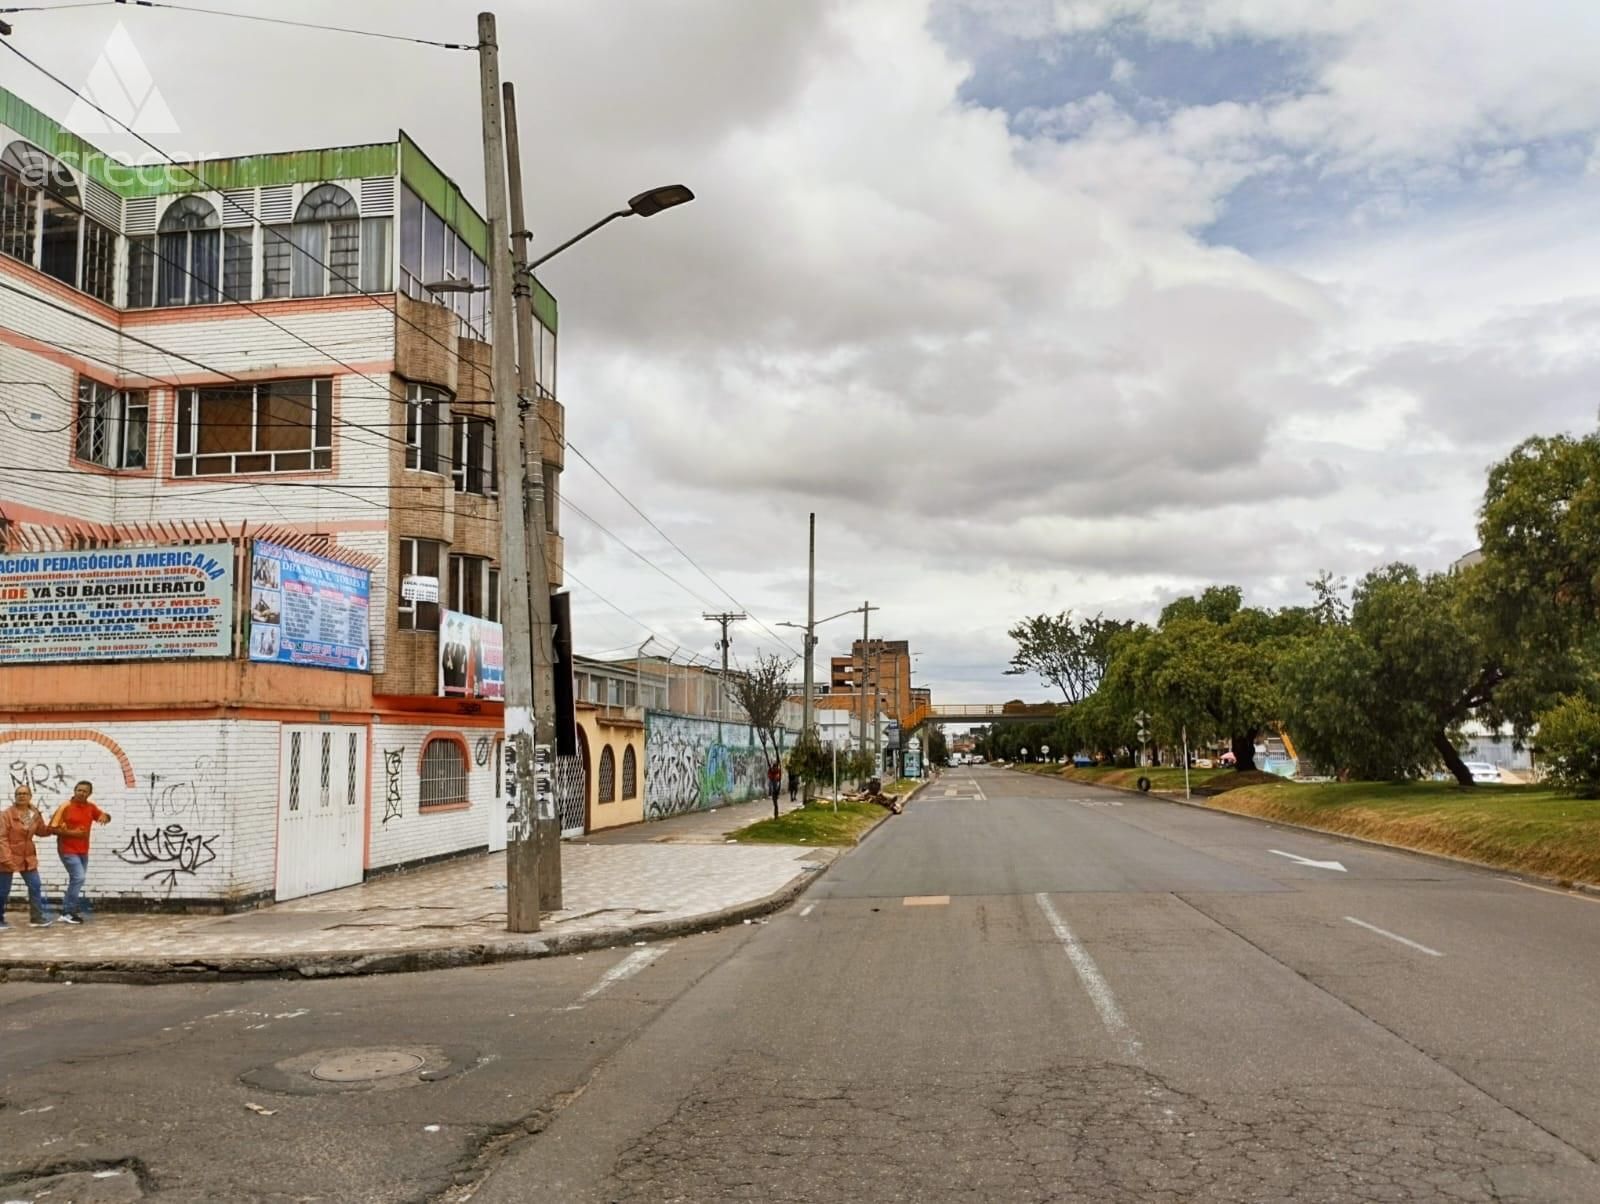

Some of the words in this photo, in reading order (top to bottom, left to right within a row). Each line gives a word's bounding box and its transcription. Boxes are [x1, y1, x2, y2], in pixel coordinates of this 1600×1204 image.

[43, 554, 132, 572] PEDAGÓGICA
[136, 551, 225, 580] AMERICANA
[76, 568, 142, 579] realizaremos
[145, 569, 161, 577] tus
[32, 587, 51, 598] YA
[55, 586, 77, 597] SU
[82, 581, 205, 597] BACHILLERATO
[170, 598, 221, 607] MESES
[58, 611, 78, 619] LA
[50, 624, 135, 634] ABIERTAS
